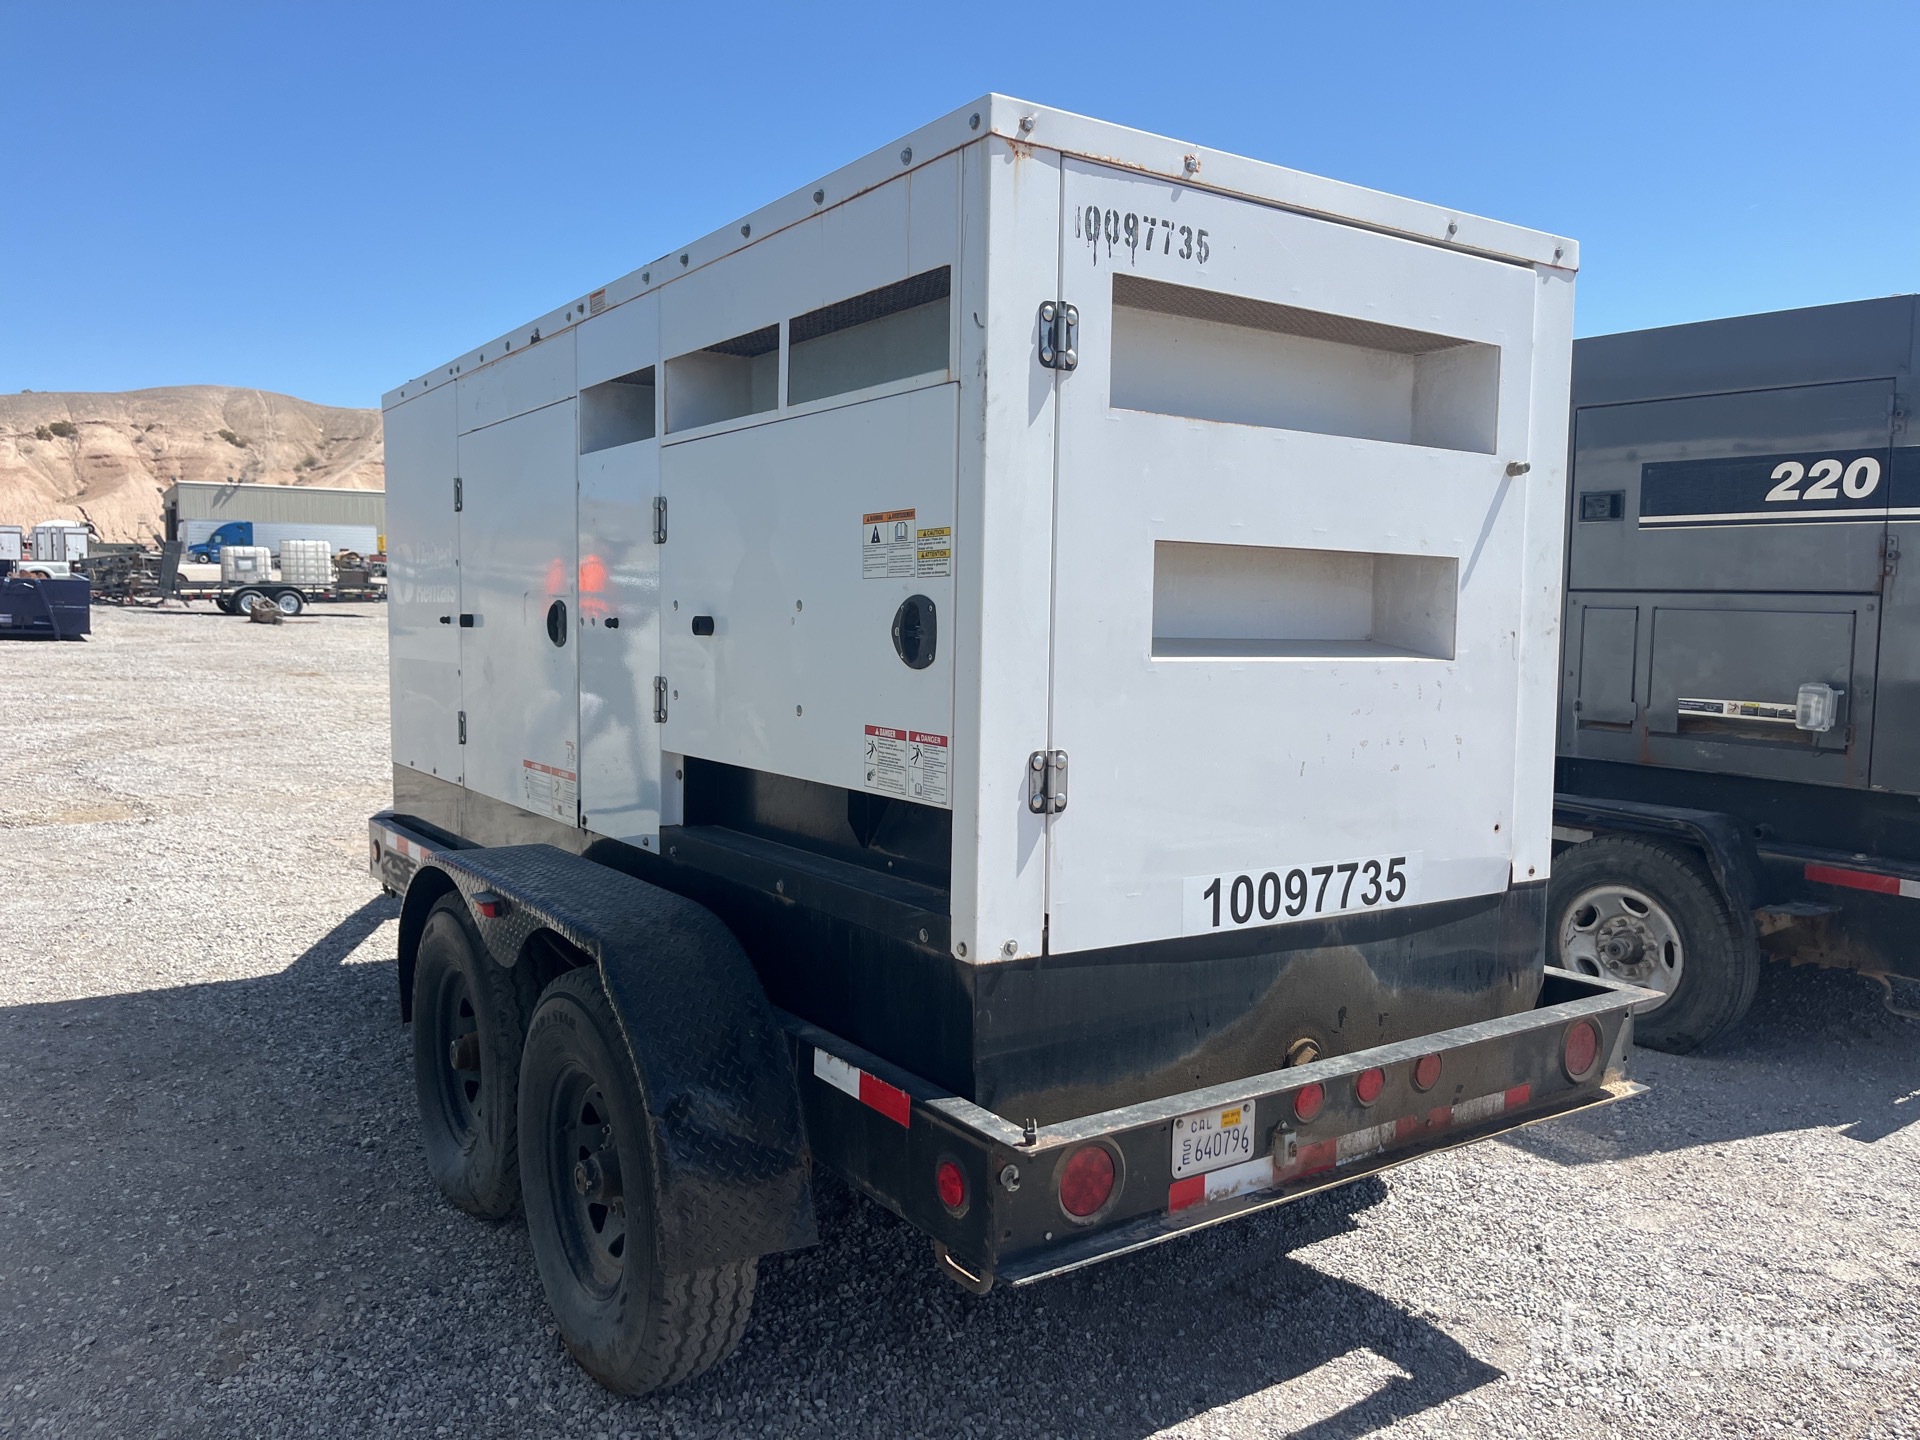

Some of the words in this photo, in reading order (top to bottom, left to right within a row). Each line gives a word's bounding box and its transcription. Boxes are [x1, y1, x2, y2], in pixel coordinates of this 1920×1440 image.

[1074, 205, 1210, 265] 10097735
[1764, 456, 1881, 502] 220
[924, 550, 947, 558] ATTENTION
[879, 728, 896, 738] DANGER
[920, 734, 941, 744] DANGER
[1203, 856, 1407, 928] 10097735
[1191, 1119, 1212, 1133] CAL
[1195, 1125, 1249, 1162] 640796
